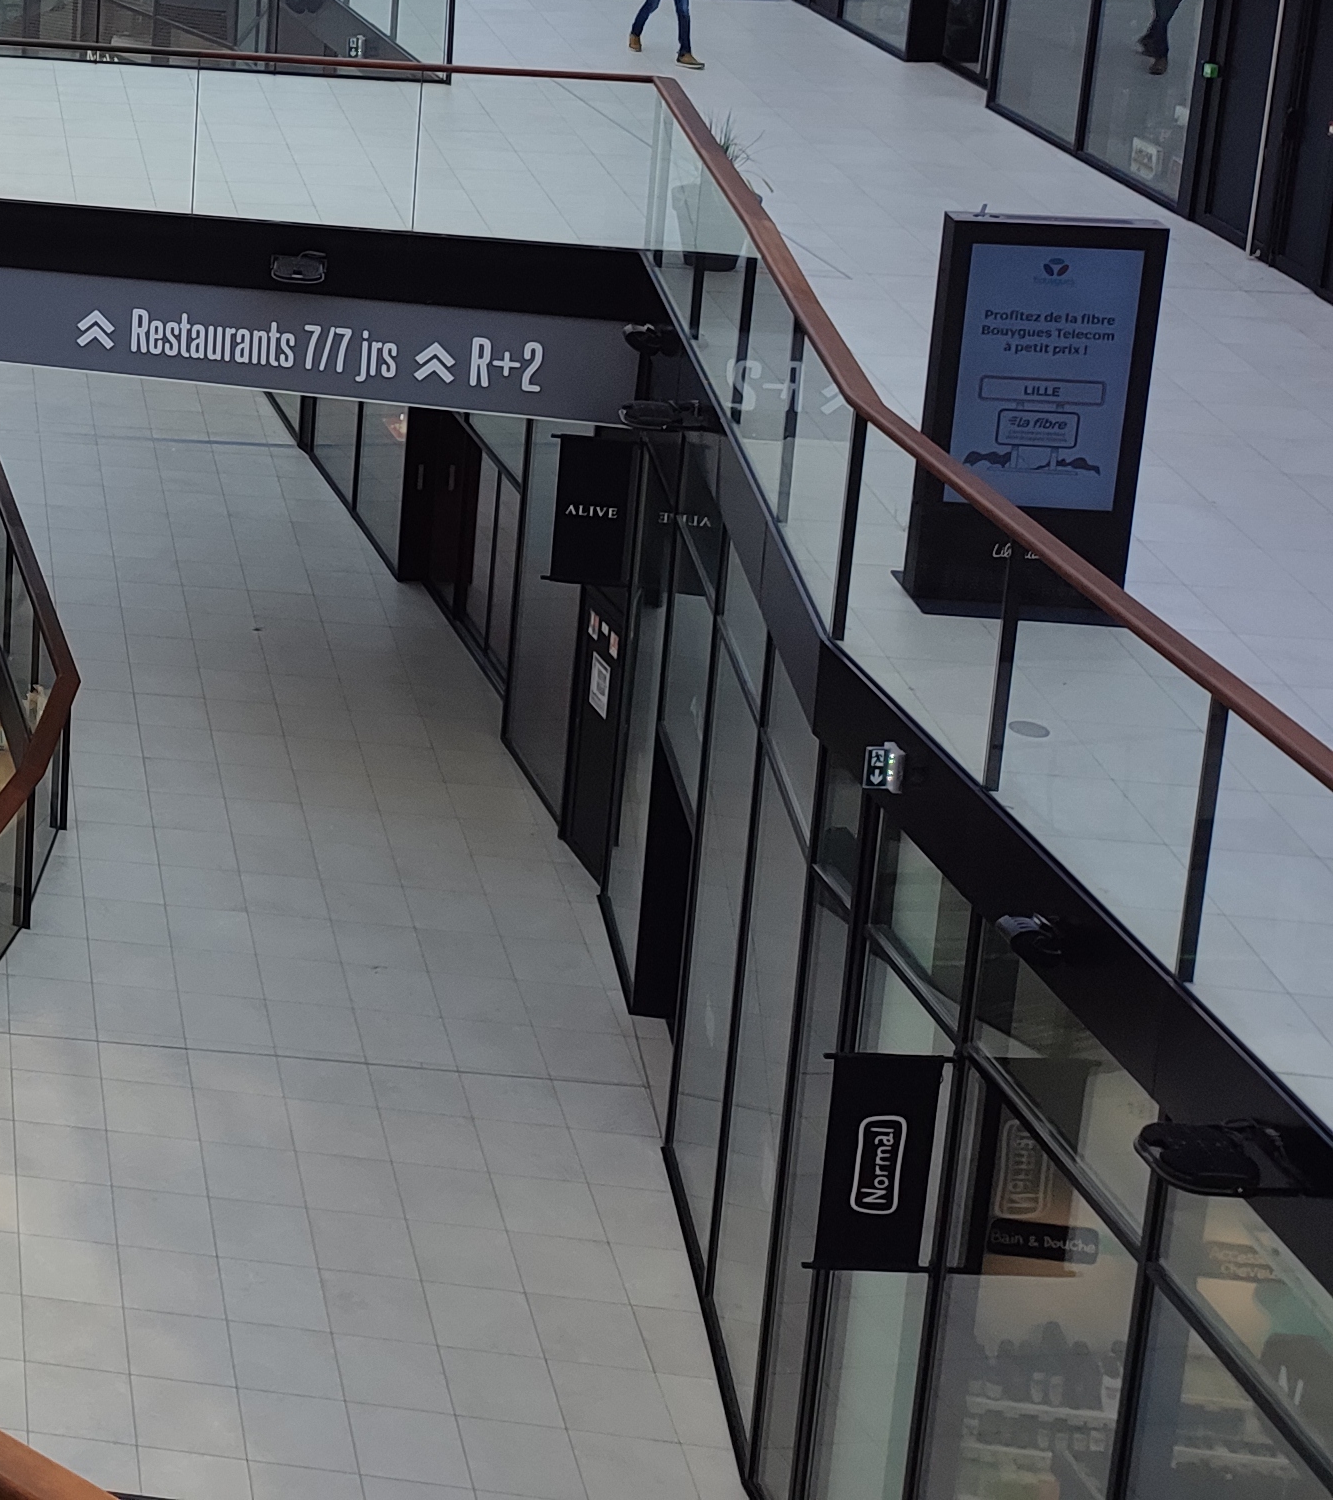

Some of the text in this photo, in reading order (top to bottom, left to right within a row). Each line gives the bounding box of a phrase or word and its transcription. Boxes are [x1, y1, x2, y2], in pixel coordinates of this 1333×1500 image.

[984, 309, 1116, 326] Profitez de la fibre
[981, 325, 1115, 341] Bouygues Telecom
[130, 308, 545, 393] Restaurants 7/7 jrs R+2
[1003, 342, 1012, 353] à
[1015, 342, 1050, 355] petit
[1052, 343, 1081, 357] prix
[1023, 385, 1062, 397] LILLE
[1017, 416, 1068, 431] la fibre
[565, 503, 619, 519] ALIVE
[860, 1127, 895, 1204] Normal
[990, 1229, 1024, 1245] Bain
[1043, 1236, 1096, 1254] Douche
